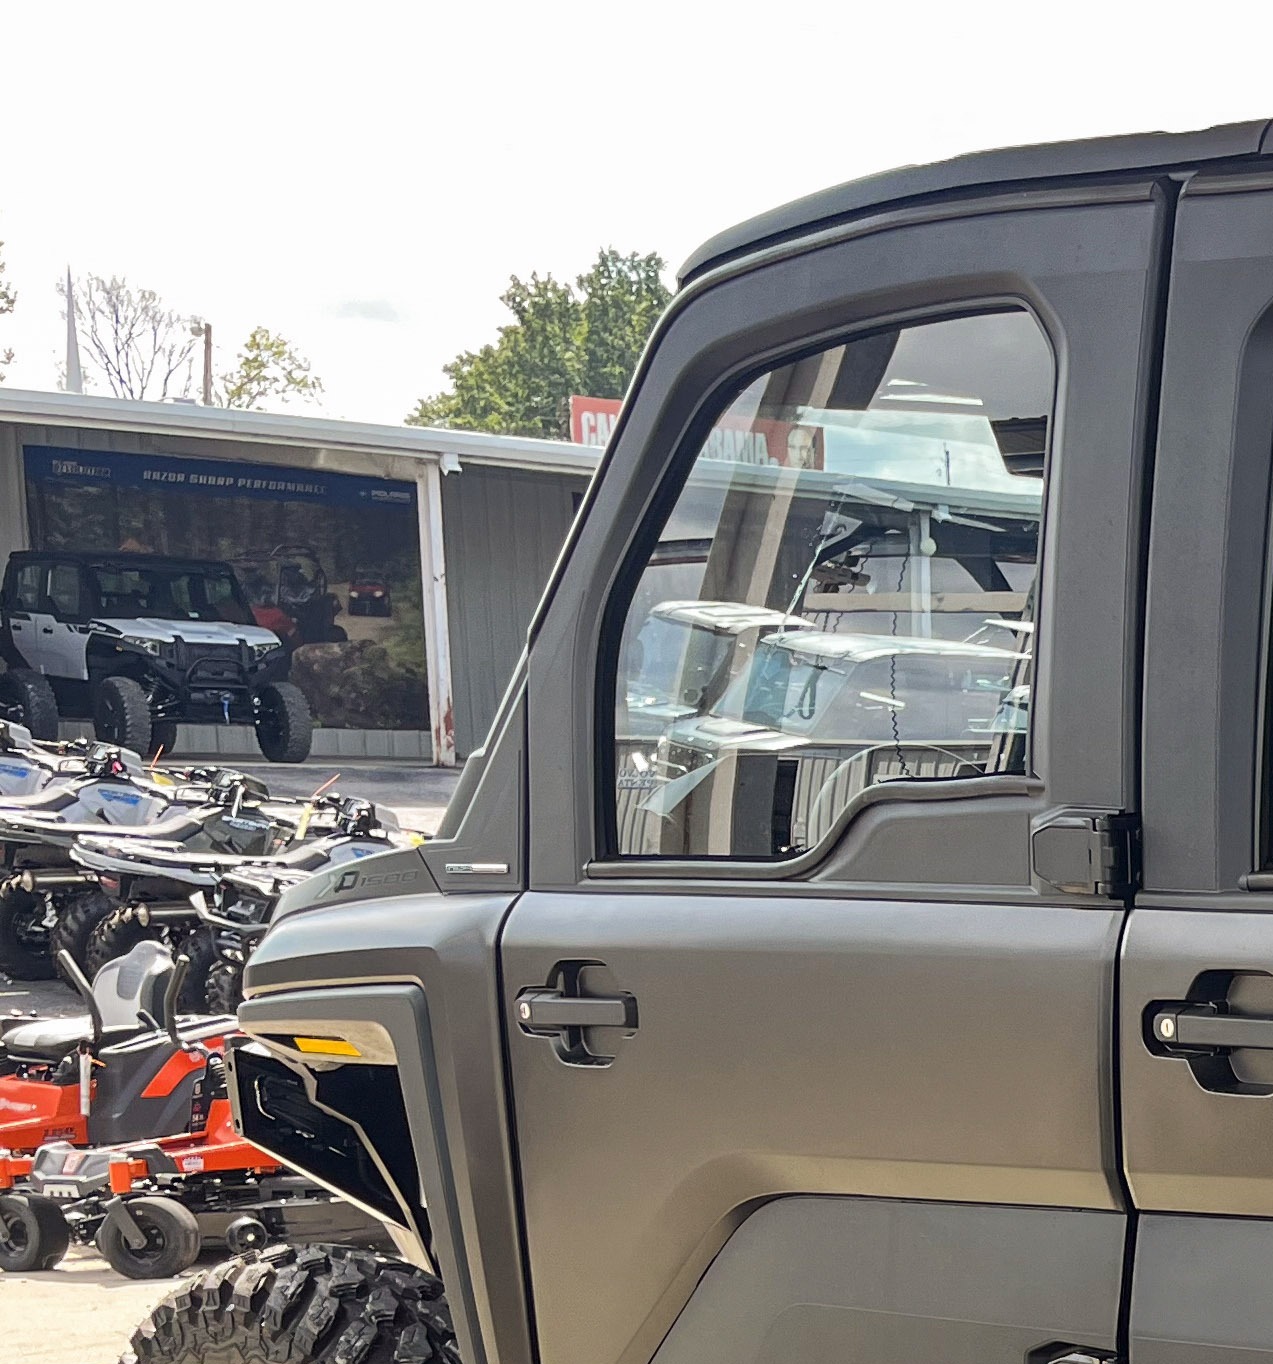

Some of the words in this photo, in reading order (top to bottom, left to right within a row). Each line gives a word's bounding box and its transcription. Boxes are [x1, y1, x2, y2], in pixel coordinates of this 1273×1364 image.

[143, 470, 186, 482] RAZOR
[189, 474, 234, 487] SHARP
[237, 478, 328, 495] PERFORMANCE
